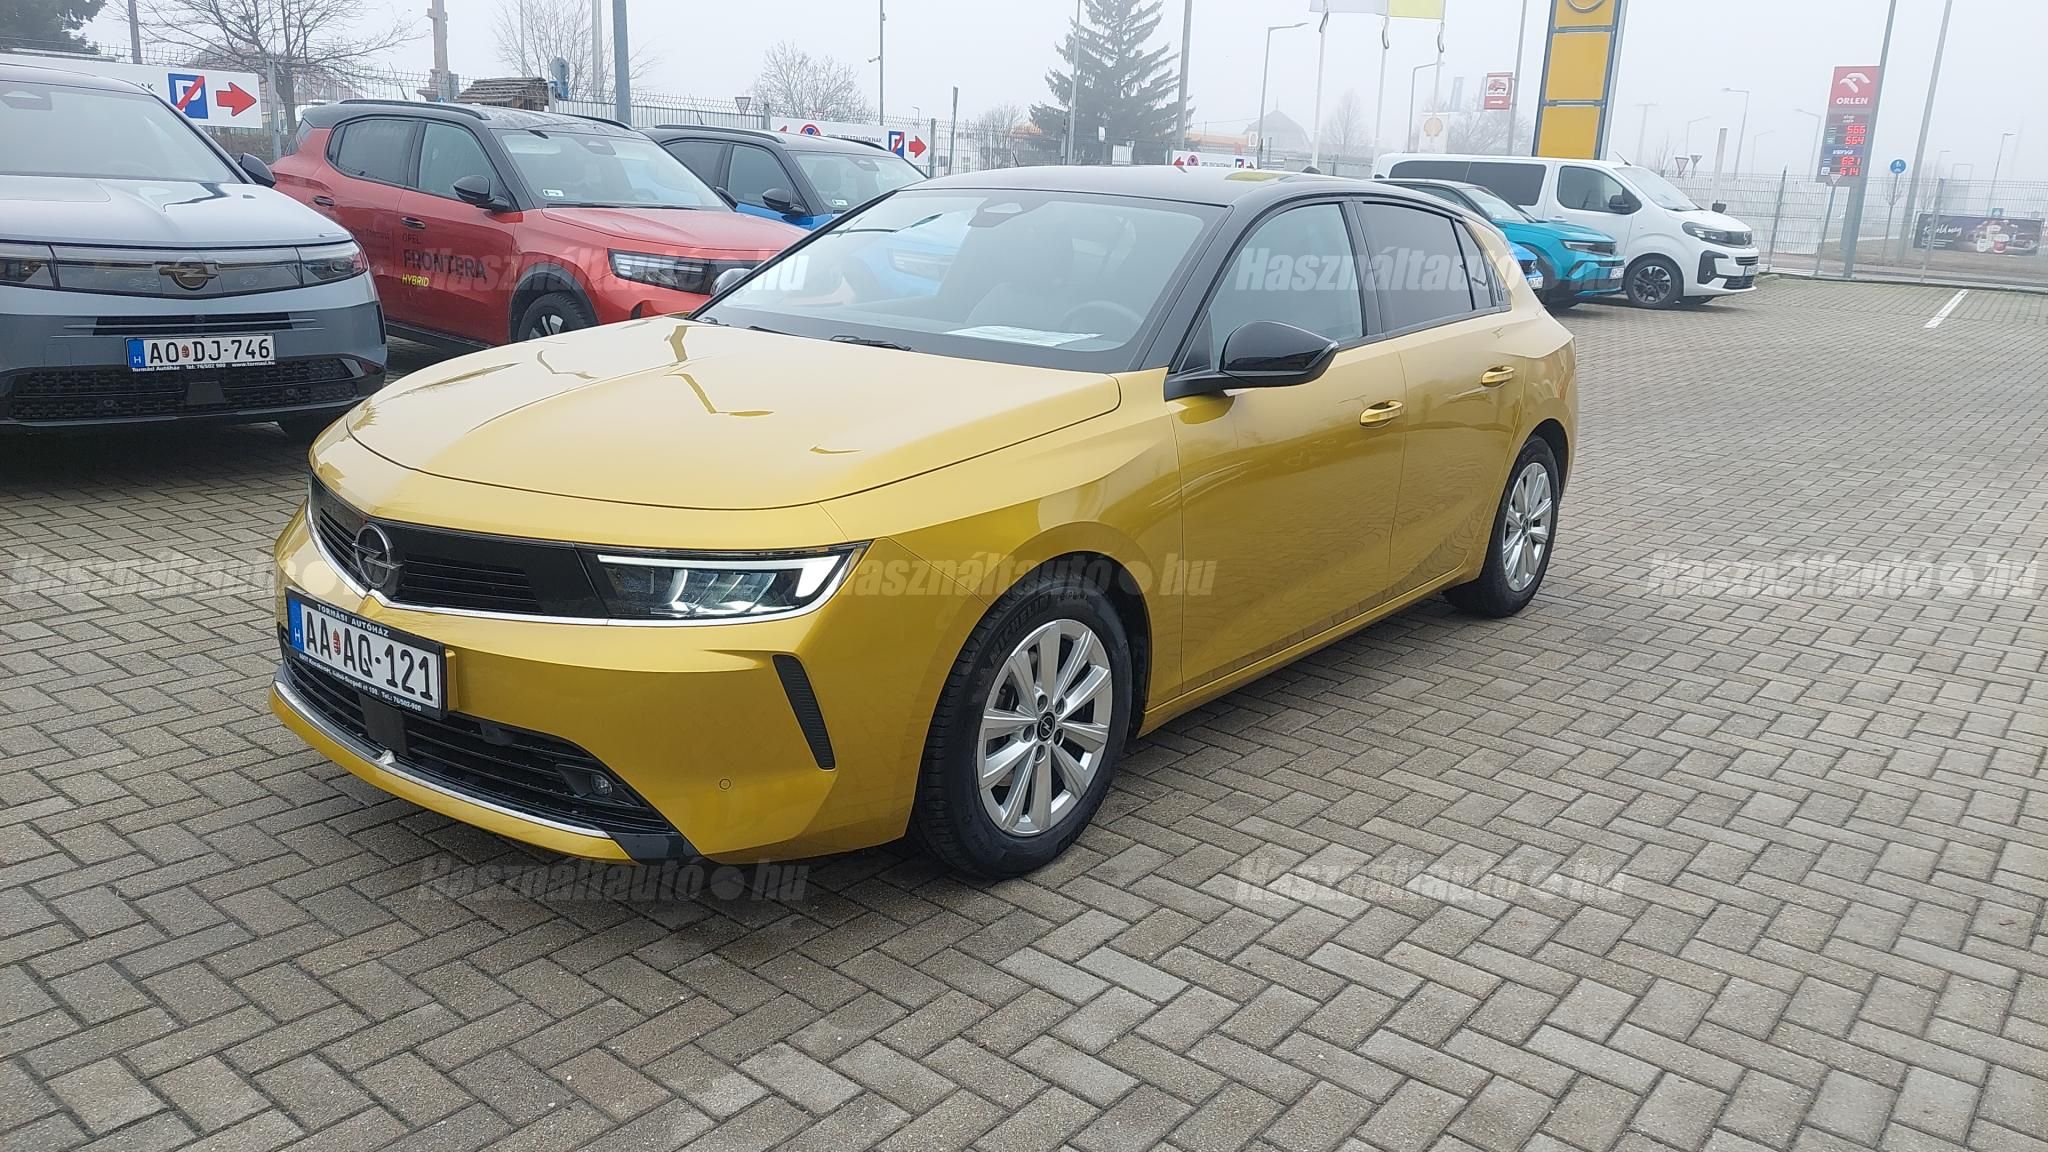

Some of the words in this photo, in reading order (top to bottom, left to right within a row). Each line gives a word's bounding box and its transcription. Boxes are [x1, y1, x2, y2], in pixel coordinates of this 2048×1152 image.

[1836, 97, 1868, 105] ORLEN
[1847, 125, 1866, 134] 566
[1845, 136, 1865, 144] 564
[1841, 157, 1861, 165] 621
[403, 248, 487, 283] FRONTERA
[402, 273, 430, 287] HYBRID
[134, 356, 141, 364] H
[150, 342, 179, 363] AO
[192, 339, 270, 362] DJ-746
[317, 603, 348, 622] TORMÁSI
[351, 618, 389, 637] AUTÓHÁZ
[294, 628, 300, 643] H
[306, 611, 332, 660] AA
[343, 628, 433, 701] AQ-121
